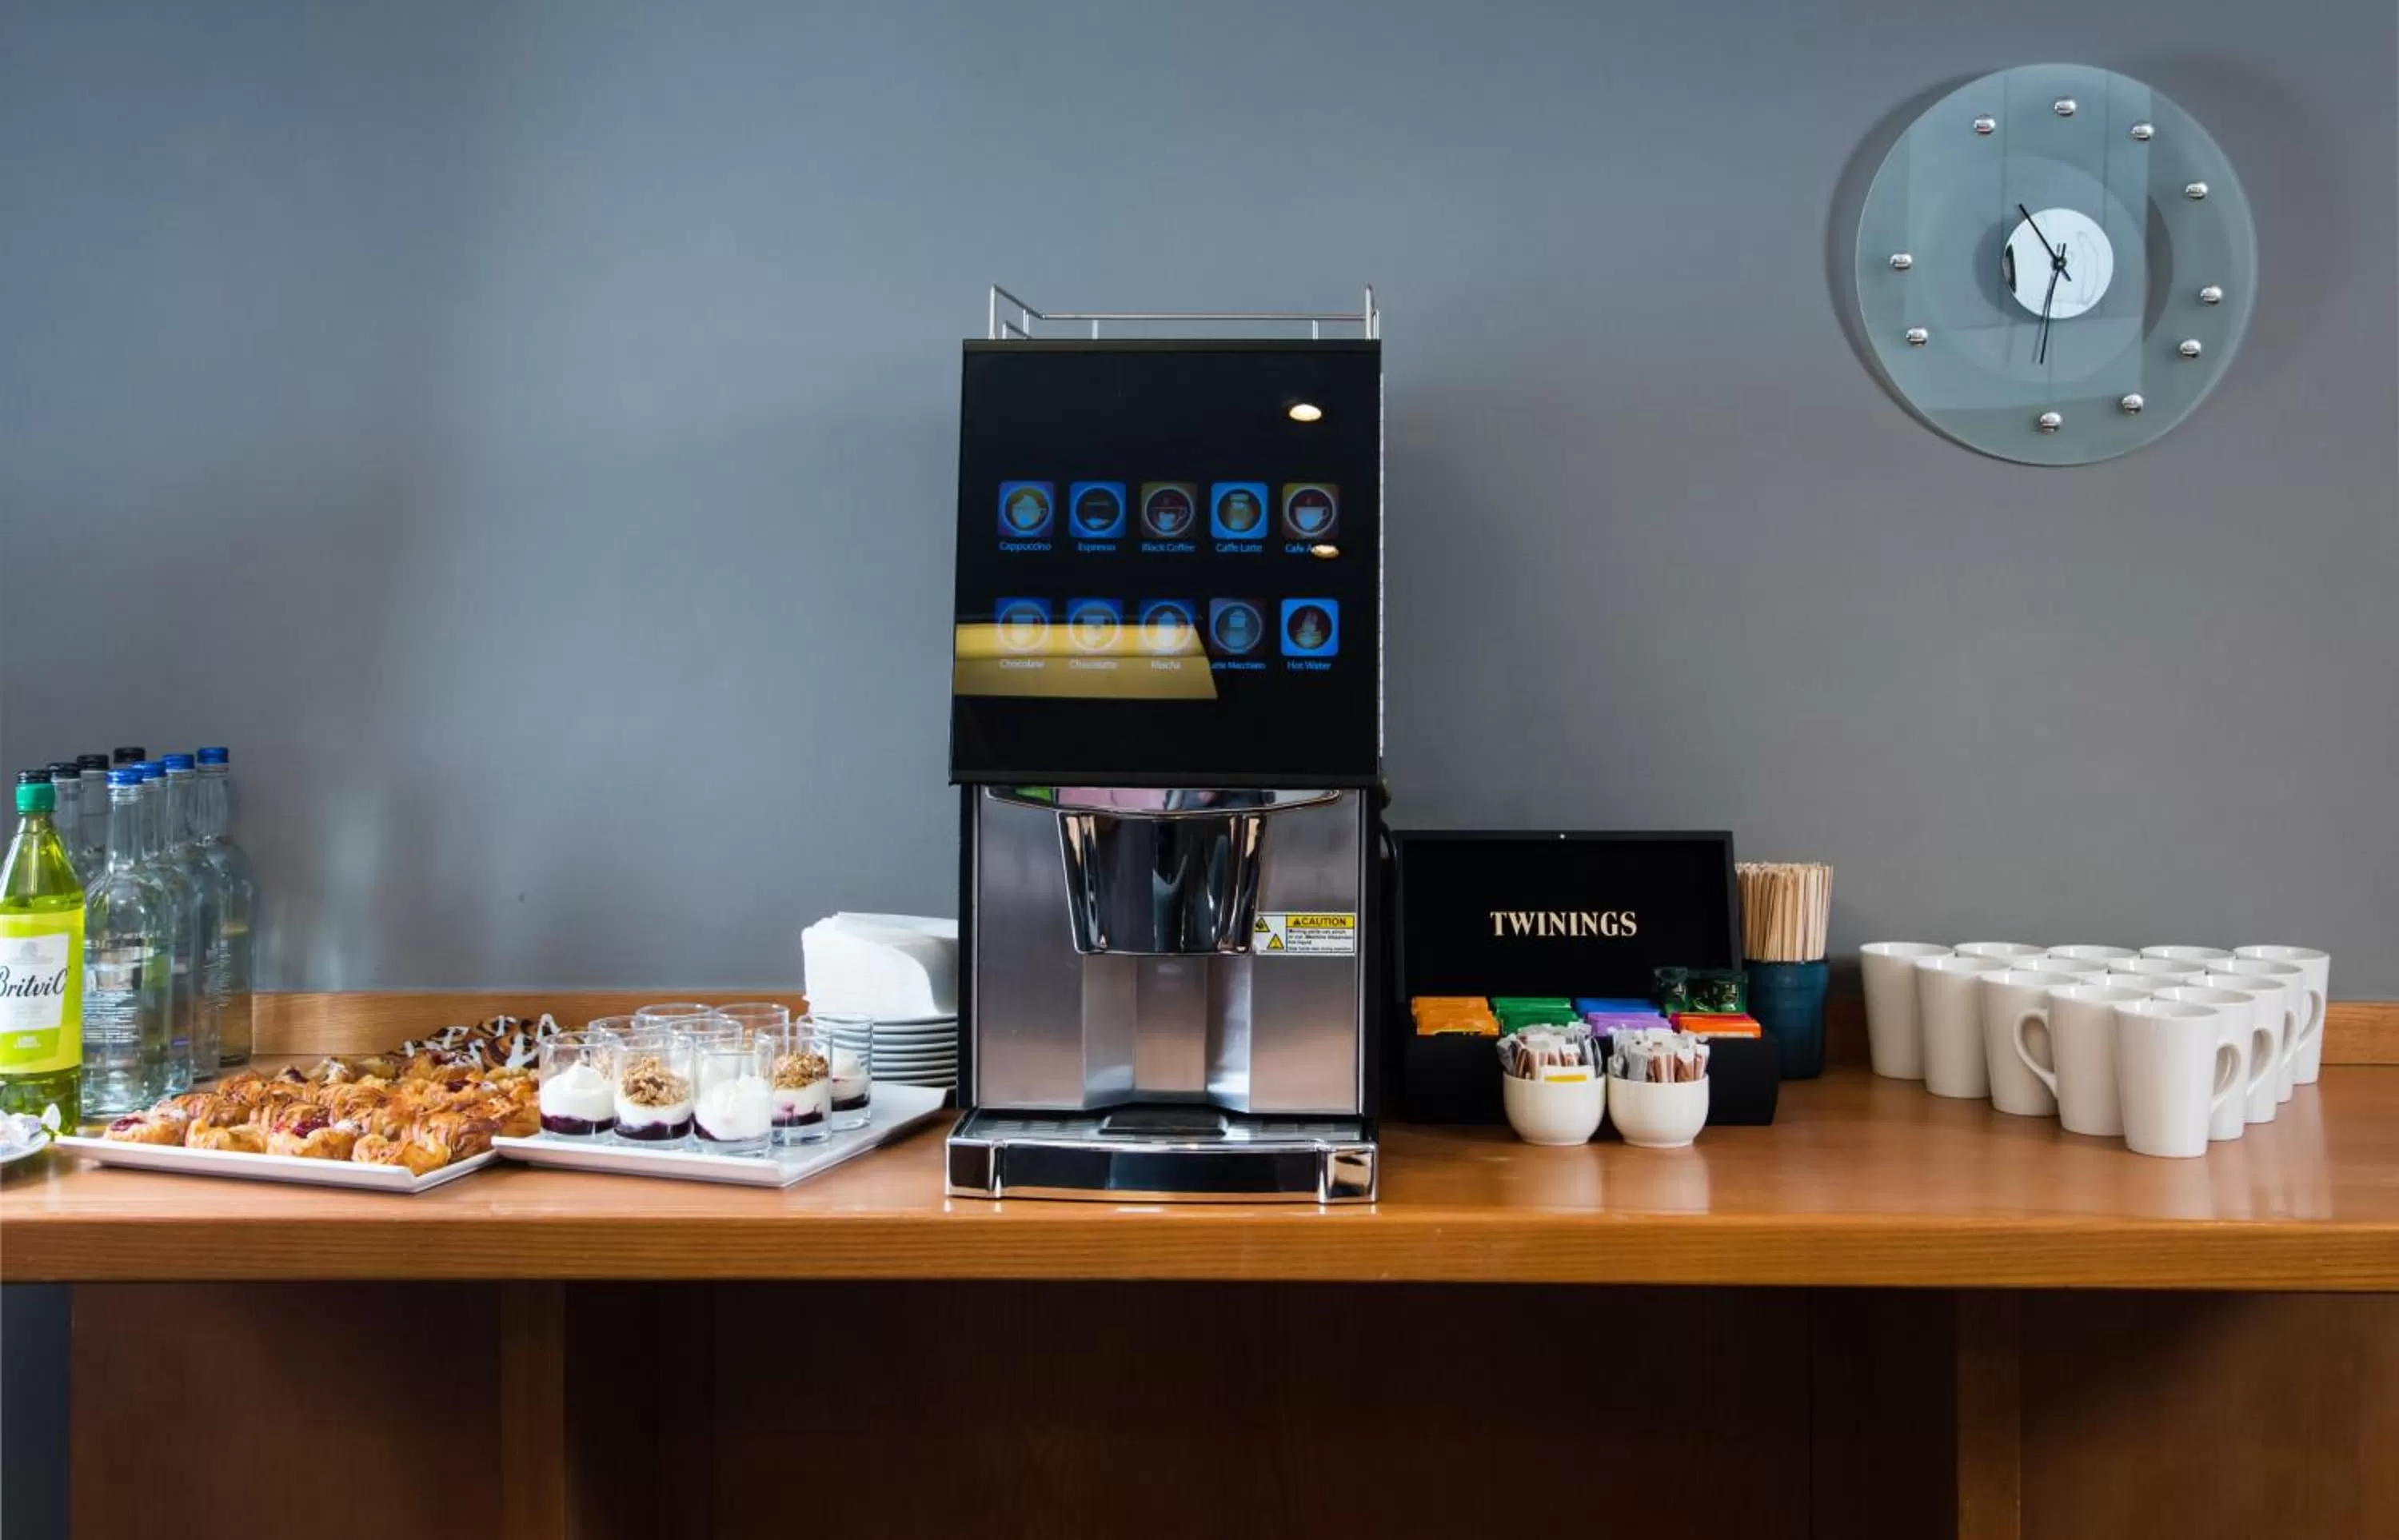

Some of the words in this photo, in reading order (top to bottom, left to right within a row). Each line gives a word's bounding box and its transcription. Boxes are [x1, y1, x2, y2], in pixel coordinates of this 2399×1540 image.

[999, 542, 1052, 553] Cappuccino
[1078, 542, 1116, 553] Espresso
[1142, 543, 1165, 553] Black
[1167, 543, 1196, 553] Coffee
[1240, 543, 1263, 553] Latte
[1287, 660, 1303, 670] Hot
[1304, 660, 1331, 671] Water
[1301, 917, 1347, 927] CAUTION
[1490, 911, 1638, 937] TWININGS
